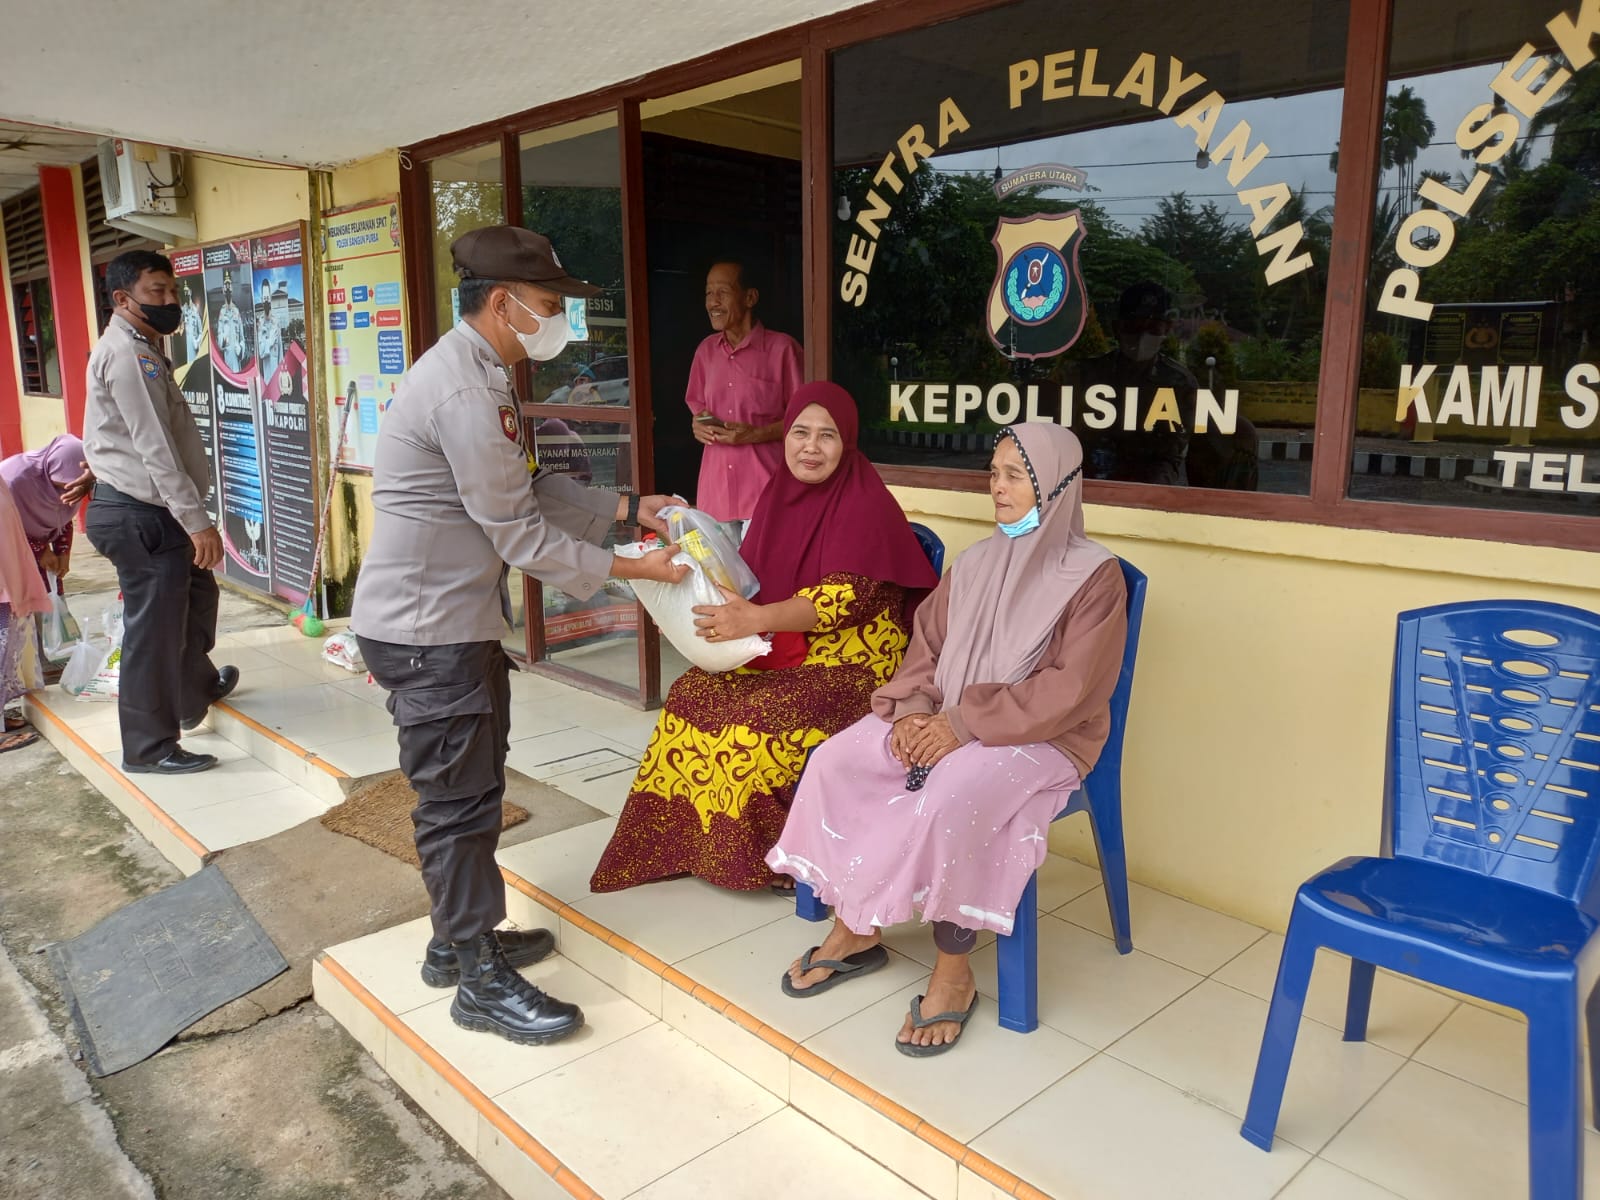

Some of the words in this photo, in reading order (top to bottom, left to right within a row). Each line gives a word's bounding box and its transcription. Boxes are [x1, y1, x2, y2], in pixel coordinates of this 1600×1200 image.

[840, 97, 971, 307] SENTRA
[1009, 48, 1313, 286] PELAYANAN
[1001, 171, 1046, 192] SUMATERA
[1049, 170, 1077, 184] UTARA
[1376, 0, 1600, 322] POLSEK
[587, 297, 614, 312] ESISI
[890, 383, 1239, 435] KEPOLISIAN
[1396, 364, 1543, 428] KAMI
[274, 415, 307, 431] KAPOLRI
[538, 448, 570, 458] AYANAN
[571, 447, 620, 458] MASYARAKAT
[1493, 450, 1600, 494] TEL
